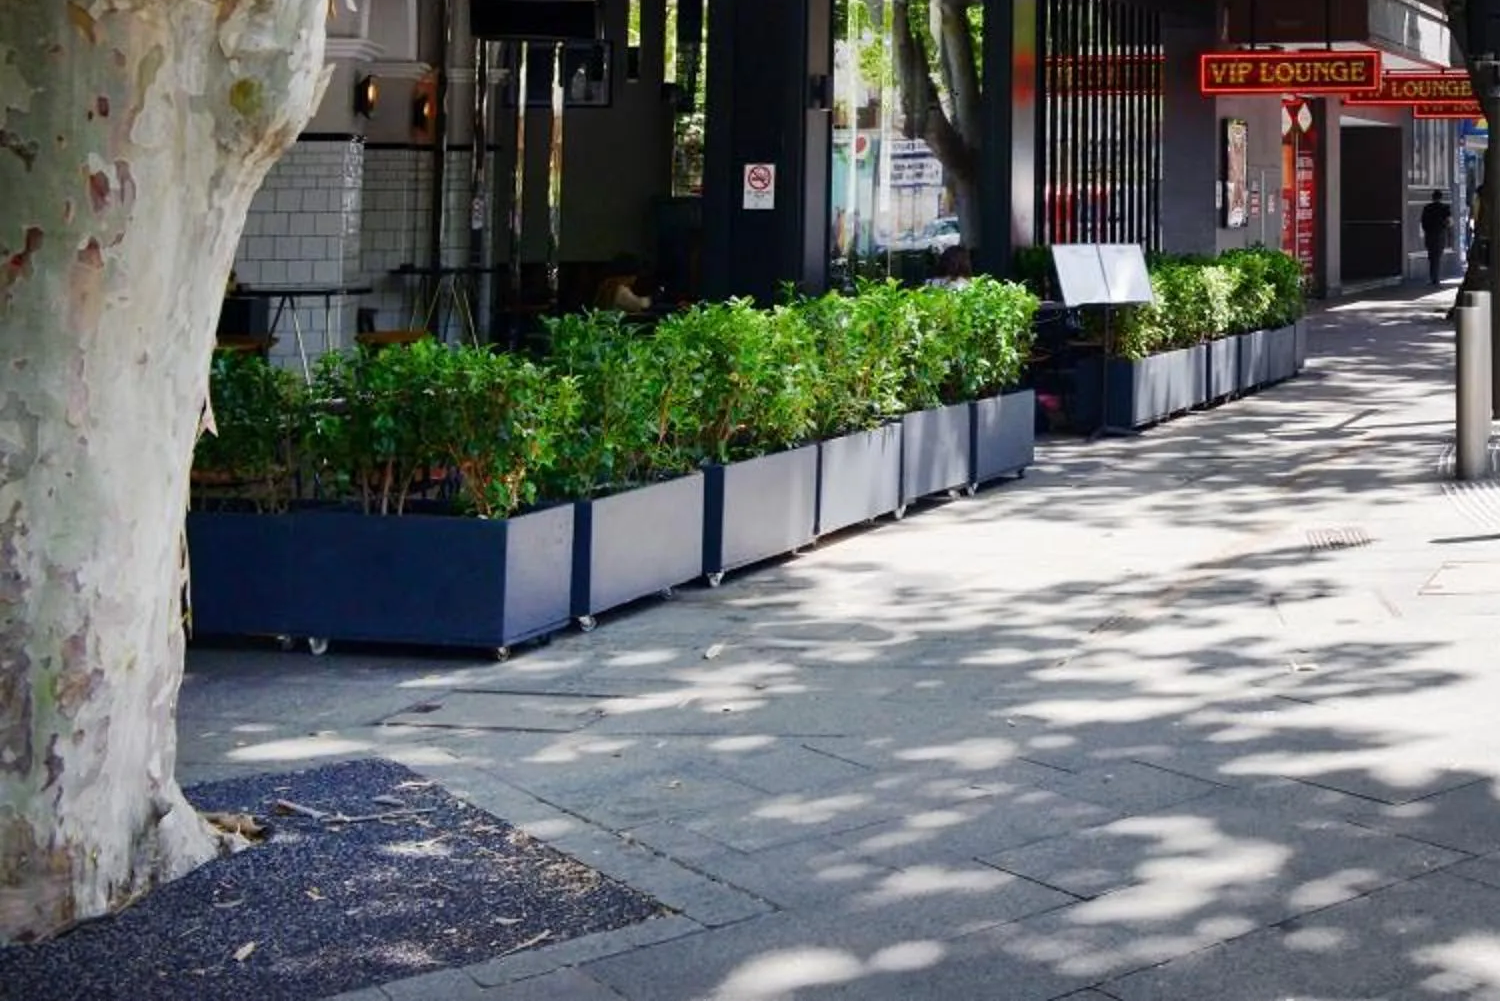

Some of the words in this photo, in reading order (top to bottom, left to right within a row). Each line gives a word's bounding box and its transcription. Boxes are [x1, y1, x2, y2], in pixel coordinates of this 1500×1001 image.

[1210, 62, 1252, 84] VIP
[1260, 60, 1366, 82] LOUNGE
[1391, 80, 1472, 97] LOUNGE
